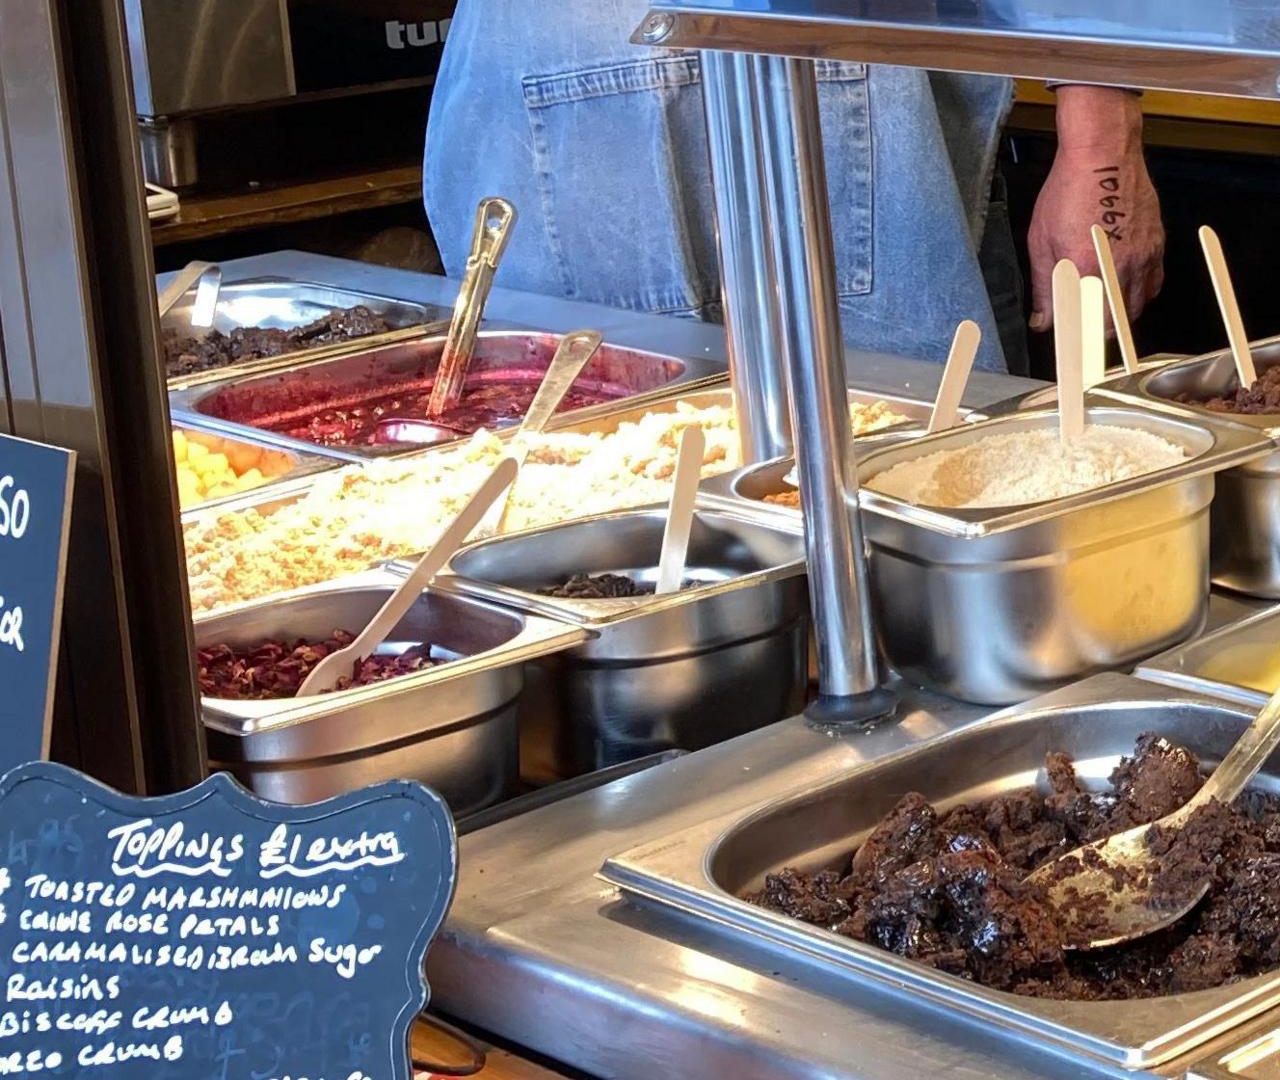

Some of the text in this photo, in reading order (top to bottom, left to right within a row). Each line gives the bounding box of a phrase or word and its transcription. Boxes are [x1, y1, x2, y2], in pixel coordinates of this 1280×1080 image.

[25, 873, 135, 908] TOASTED
[105, 909, 169, 935] ROSE
[180, 914, 280, 939] PETALS
